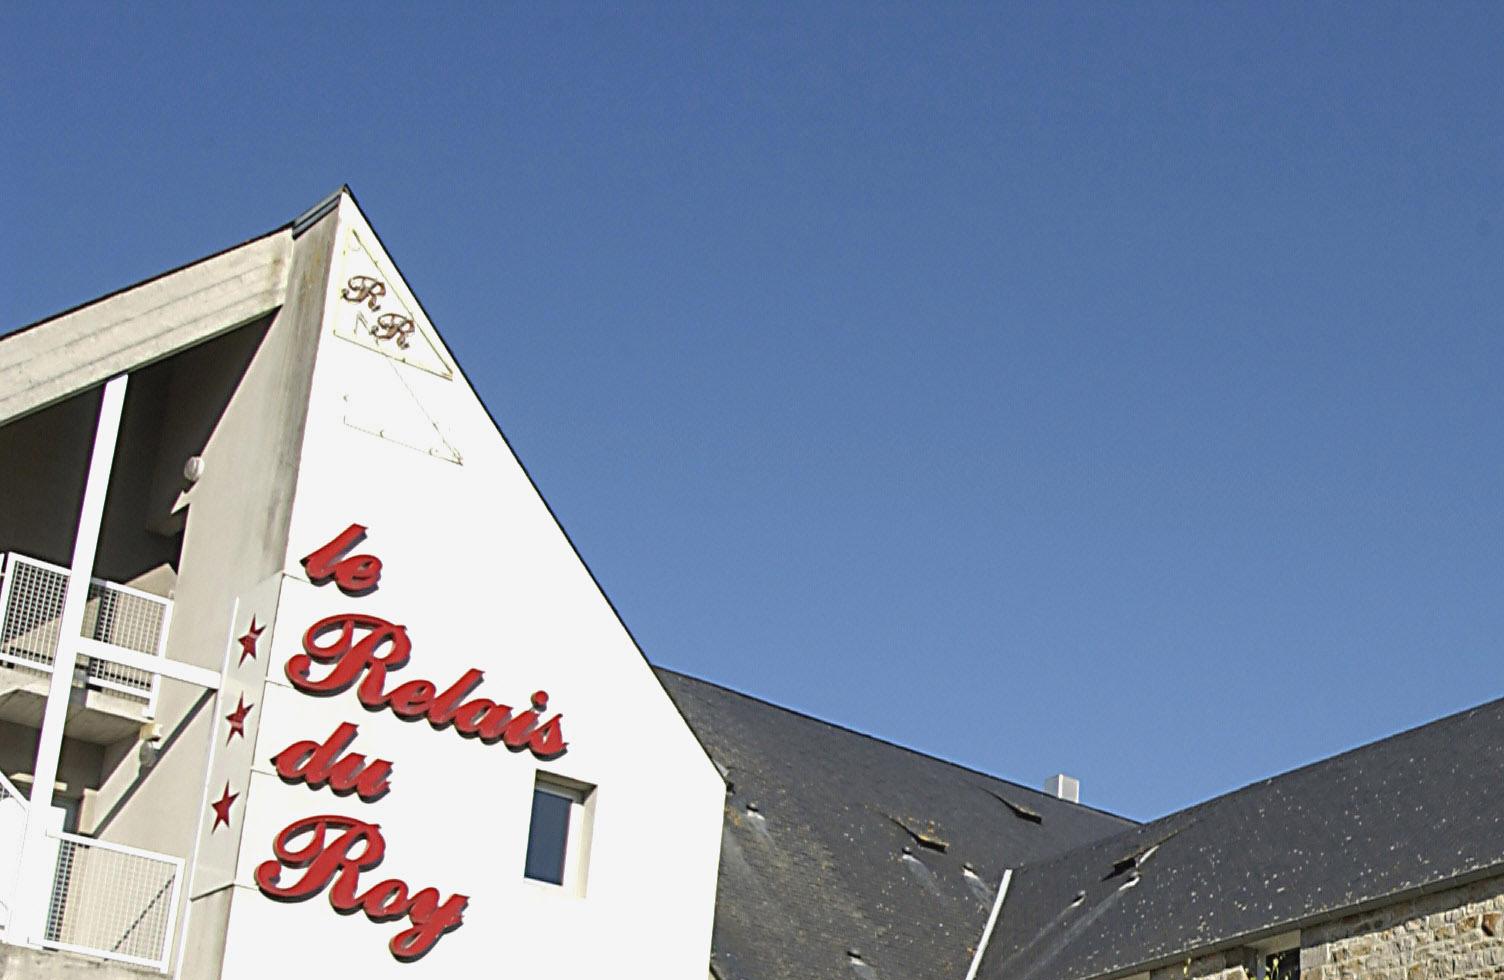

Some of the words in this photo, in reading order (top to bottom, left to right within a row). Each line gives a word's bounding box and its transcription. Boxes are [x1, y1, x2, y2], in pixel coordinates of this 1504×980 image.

[300, 523, 382, 597] le
[284, 613, 569, 761] Relais
[269, 722, 393, 802] du
[254, 815, 470, 963] Roy
